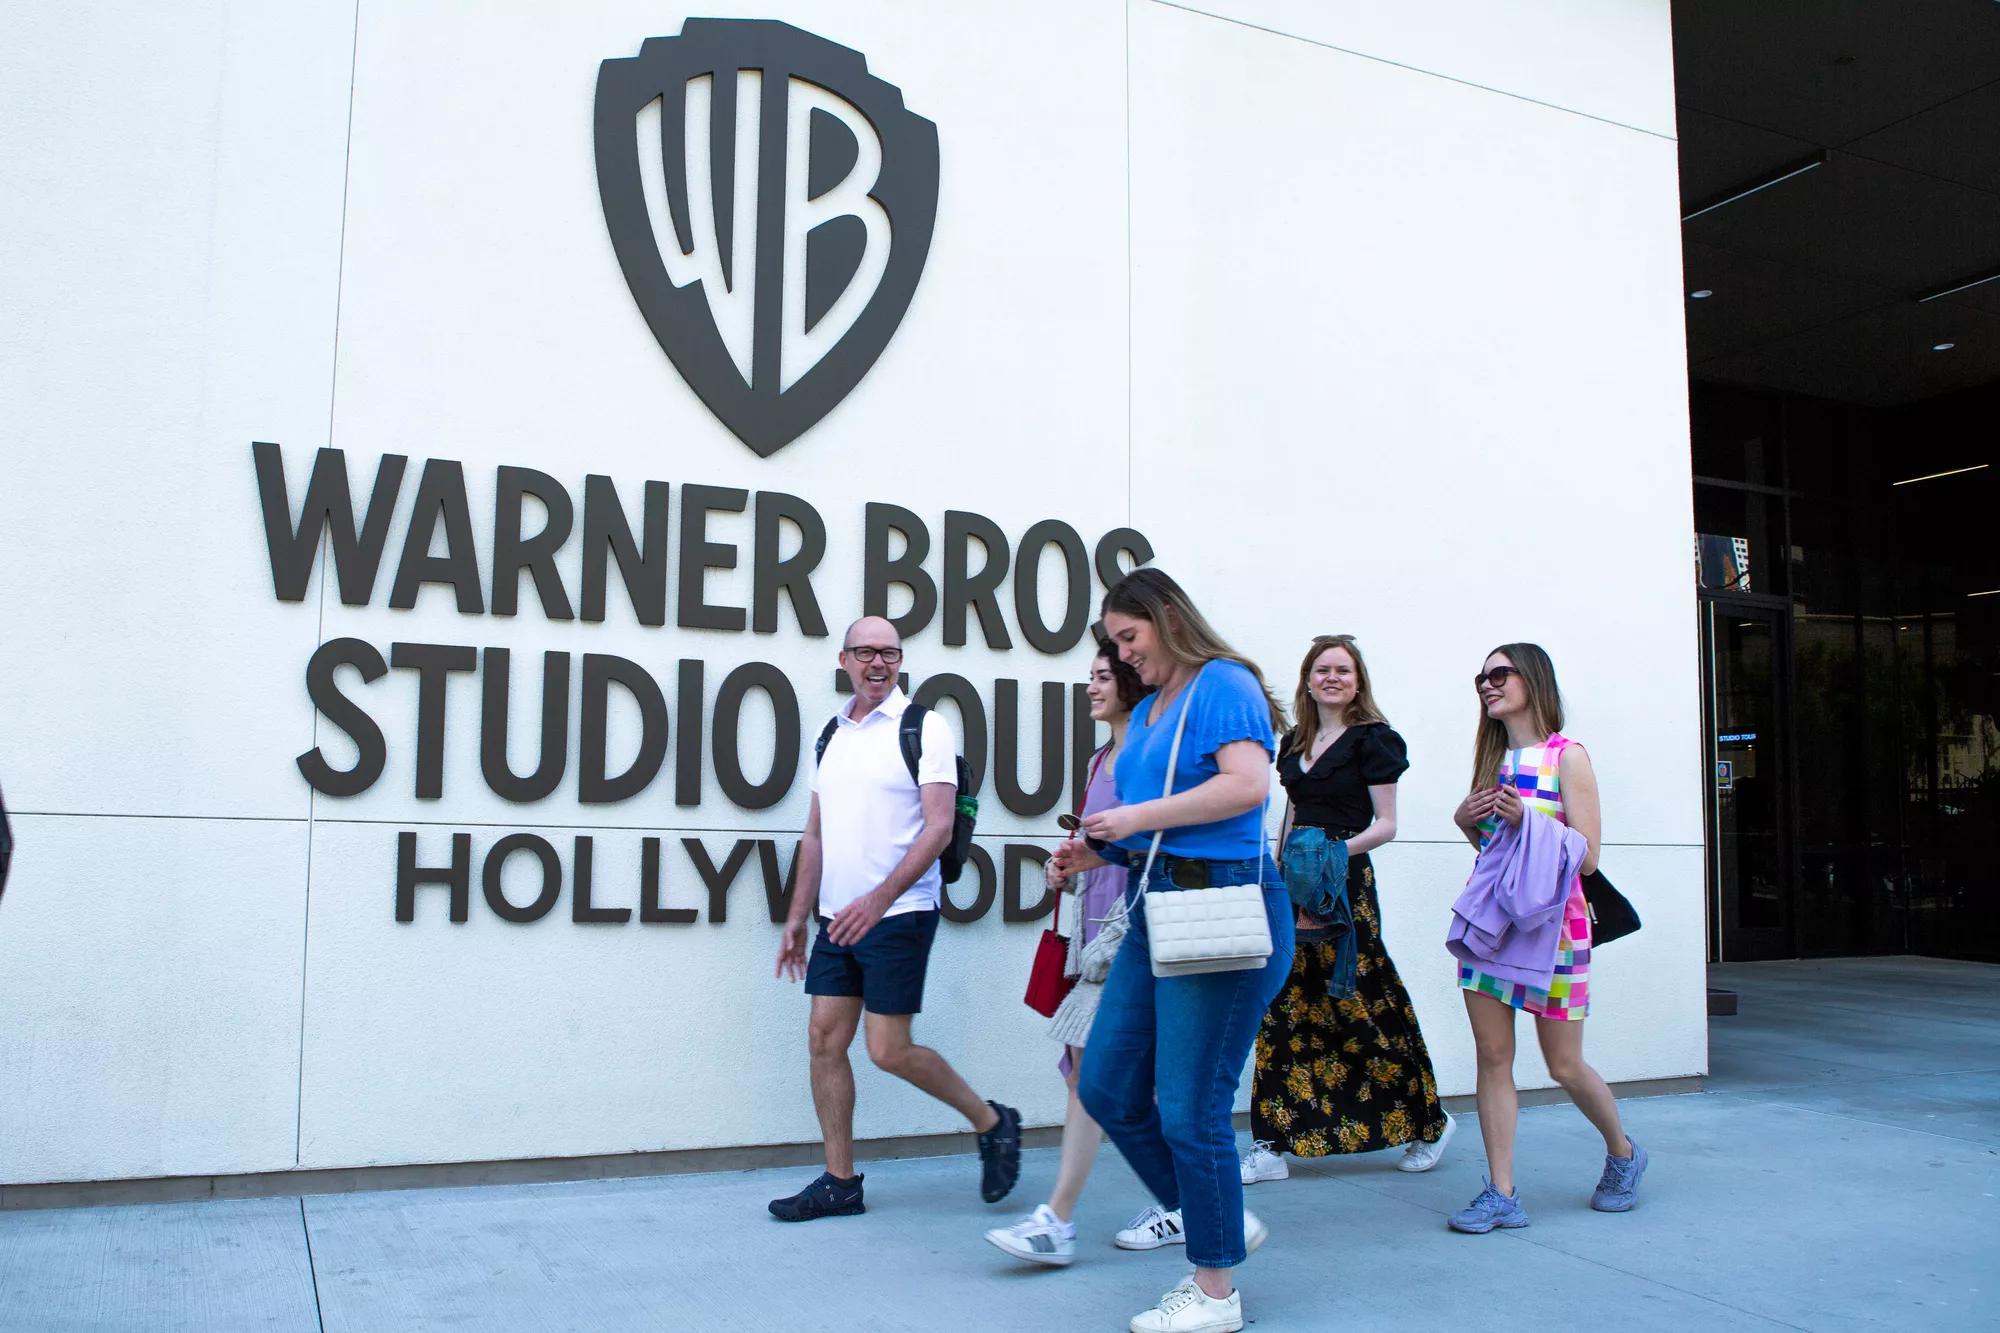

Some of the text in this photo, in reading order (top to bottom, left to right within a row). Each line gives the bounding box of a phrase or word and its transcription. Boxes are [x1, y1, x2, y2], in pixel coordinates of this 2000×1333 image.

[252, 441, 829, 637] WARNER
[296, 637, 801, 809] STUDIO
[395, 831, 1058, 923] HOLLYOD
